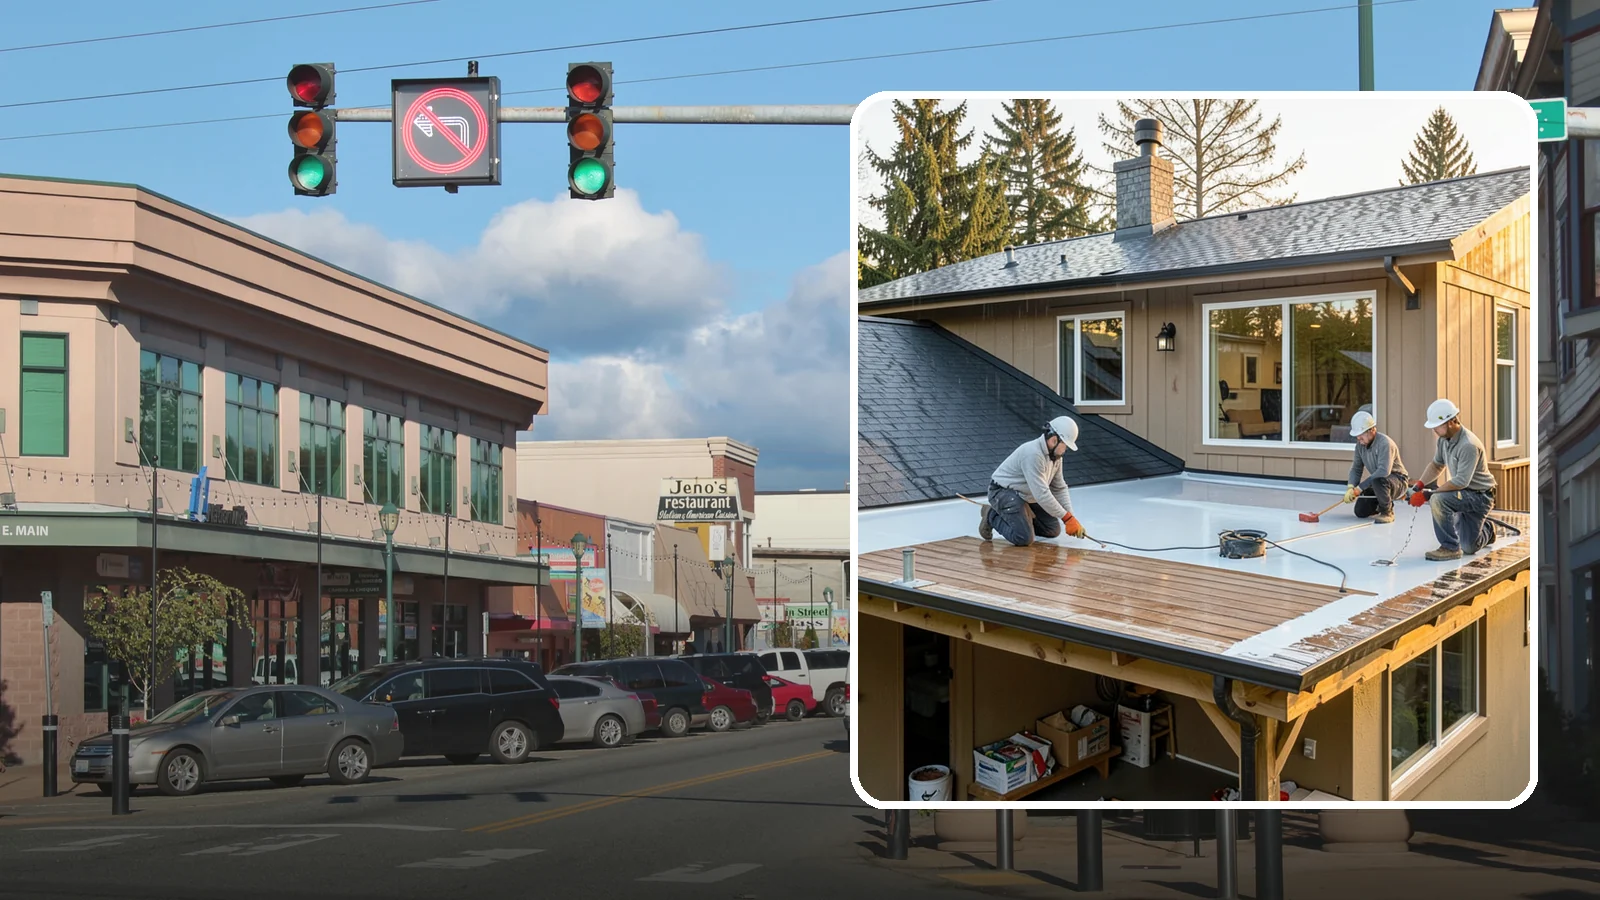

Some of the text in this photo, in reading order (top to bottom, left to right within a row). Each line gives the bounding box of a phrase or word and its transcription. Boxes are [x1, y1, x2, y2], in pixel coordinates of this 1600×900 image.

[669, 480, 728, 495] Jeno's
[665, 496, 731, 509] restaurant
[658, 509, 681, 520] Italian
[685, 509, 714, 519] American
[715, 509, 738, 519] Cuisine
[2, 525, 49, 536] E. MAIN
[797, 607, 828, 617] Street
[791, 619, 824, 627] lass
